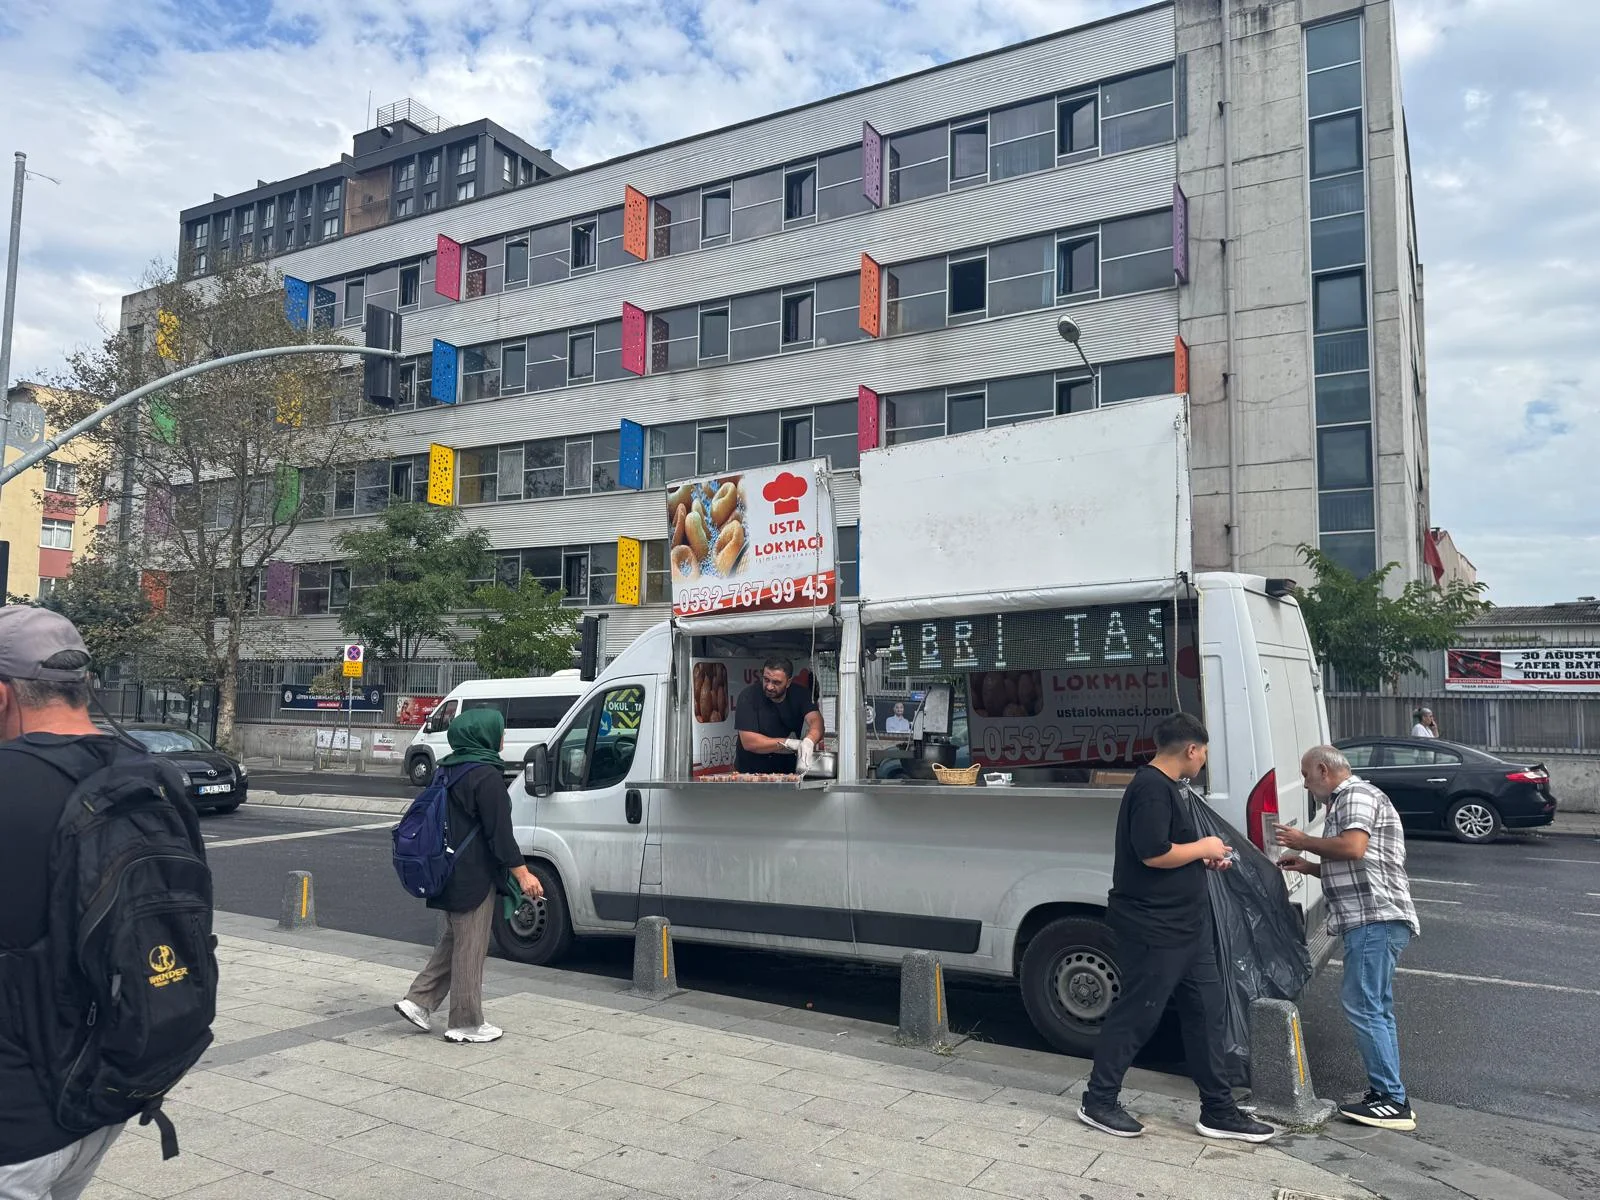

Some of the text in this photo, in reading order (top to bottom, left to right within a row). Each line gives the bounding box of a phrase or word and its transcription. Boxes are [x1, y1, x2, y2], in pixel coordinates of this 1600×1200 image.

[769, 520, 805, 535] USTA
[755, 536, 823, 556] LOKMACI
[679, 574, 828, 613] 0532 767 99 45
[1521, 651, 1540, 660] 30
[1514, 661, 1560, 670] ZAFER
[1053, 671, 1169, 692] LOKMACI
[1523, 671, 1561, 679] KUTLU
[608, 702, 629, 711] OKUL
[1057, 704, 1174, 718] ustalokmaci.com
[983, 726, 1064, 762] 0532
[1073, 724, 1139, 762] 767
